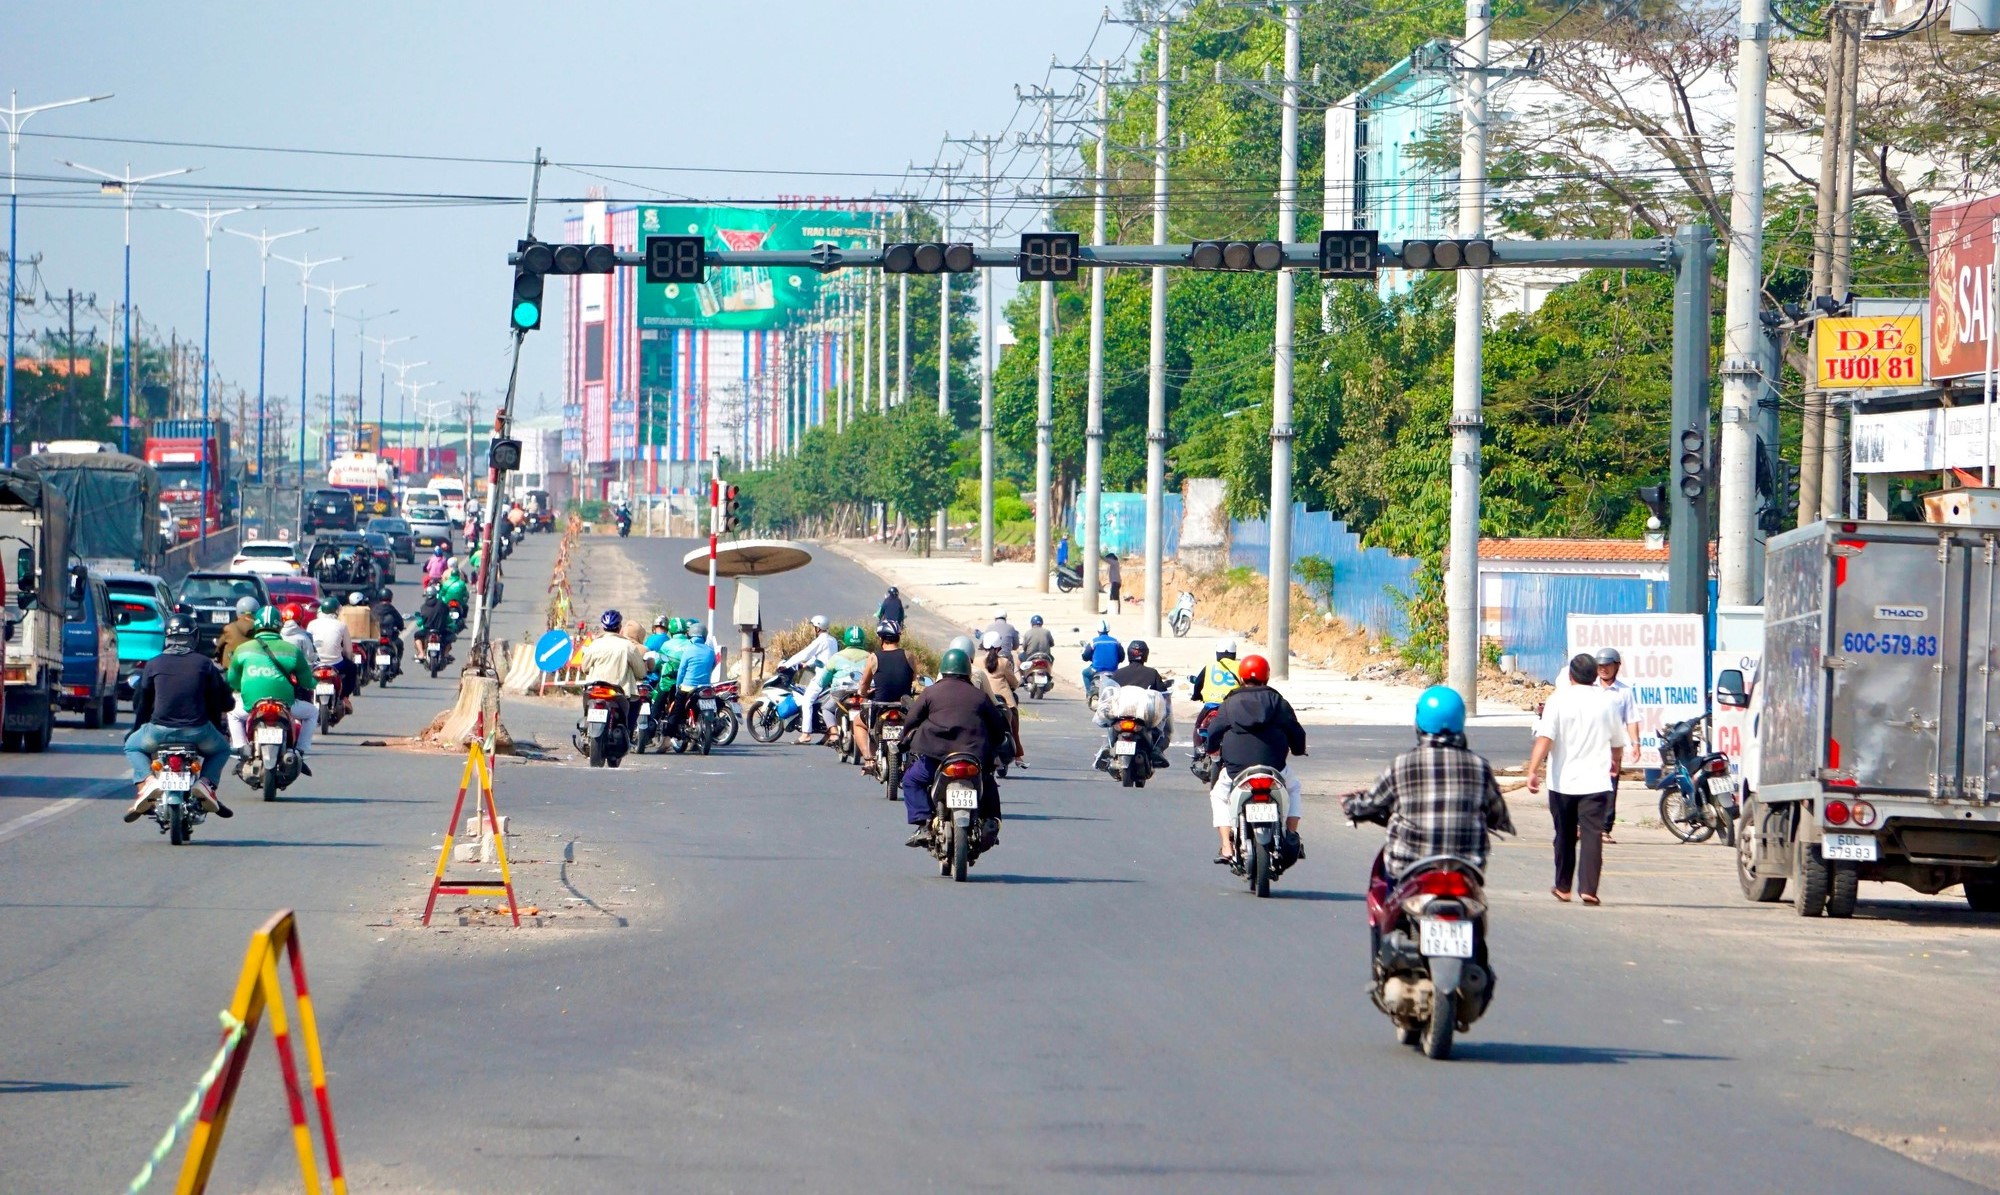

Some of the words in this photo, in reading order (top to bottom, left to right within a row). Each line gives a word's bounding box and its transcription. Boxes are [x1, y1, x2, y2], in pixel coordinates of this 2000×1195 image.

[1836, 323, 1903, 351] DÊ
[1888, 357, 1914, 379] 81
[1880, 608, 1924, 618] THACO
[1575, 621, 1633, 647] BÁNH
[1640, 624, 1697, 647] CANH
[1634, 651, 1673, 678] LÓC
[1740, 656, 1758, 671] Qu
[1211, 664, 1236, 687] be
[1641, 687, 1662, 705] NHA
[1665, 687, 1697, 705] TRANG
[952, 799, 973, 807] 1339
[1838, 834, 1860, 845] 60C
